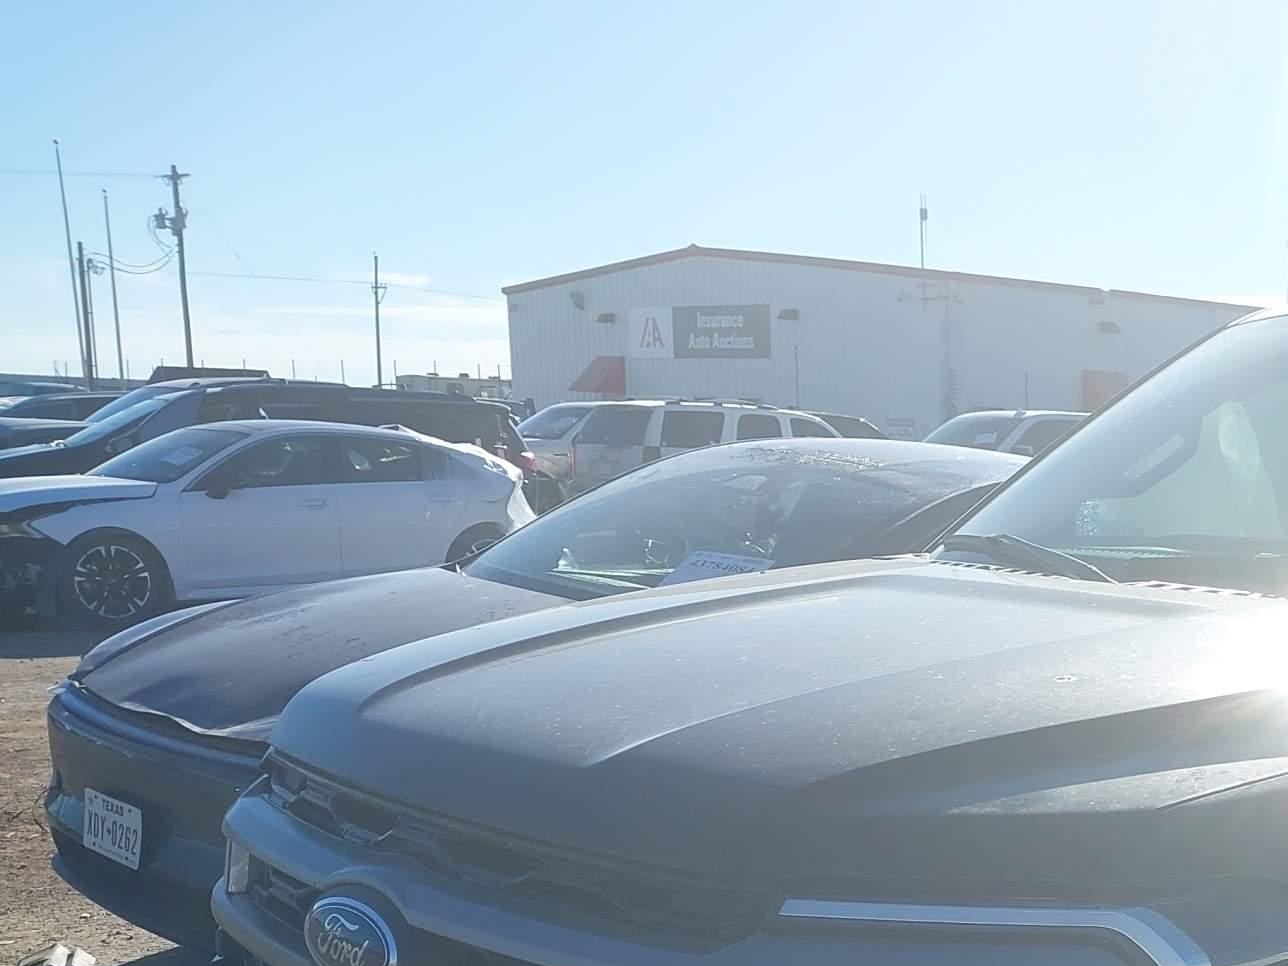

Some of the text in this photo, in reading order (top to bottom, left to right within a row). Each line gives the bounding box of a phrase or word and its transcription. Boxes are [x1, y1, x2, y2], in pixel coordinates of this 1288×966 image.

[696, 311, 744, 328] Insurance
[688, 332, 754, 349] Auto Auctions
[102, 799, 124, 817] TEXAS
